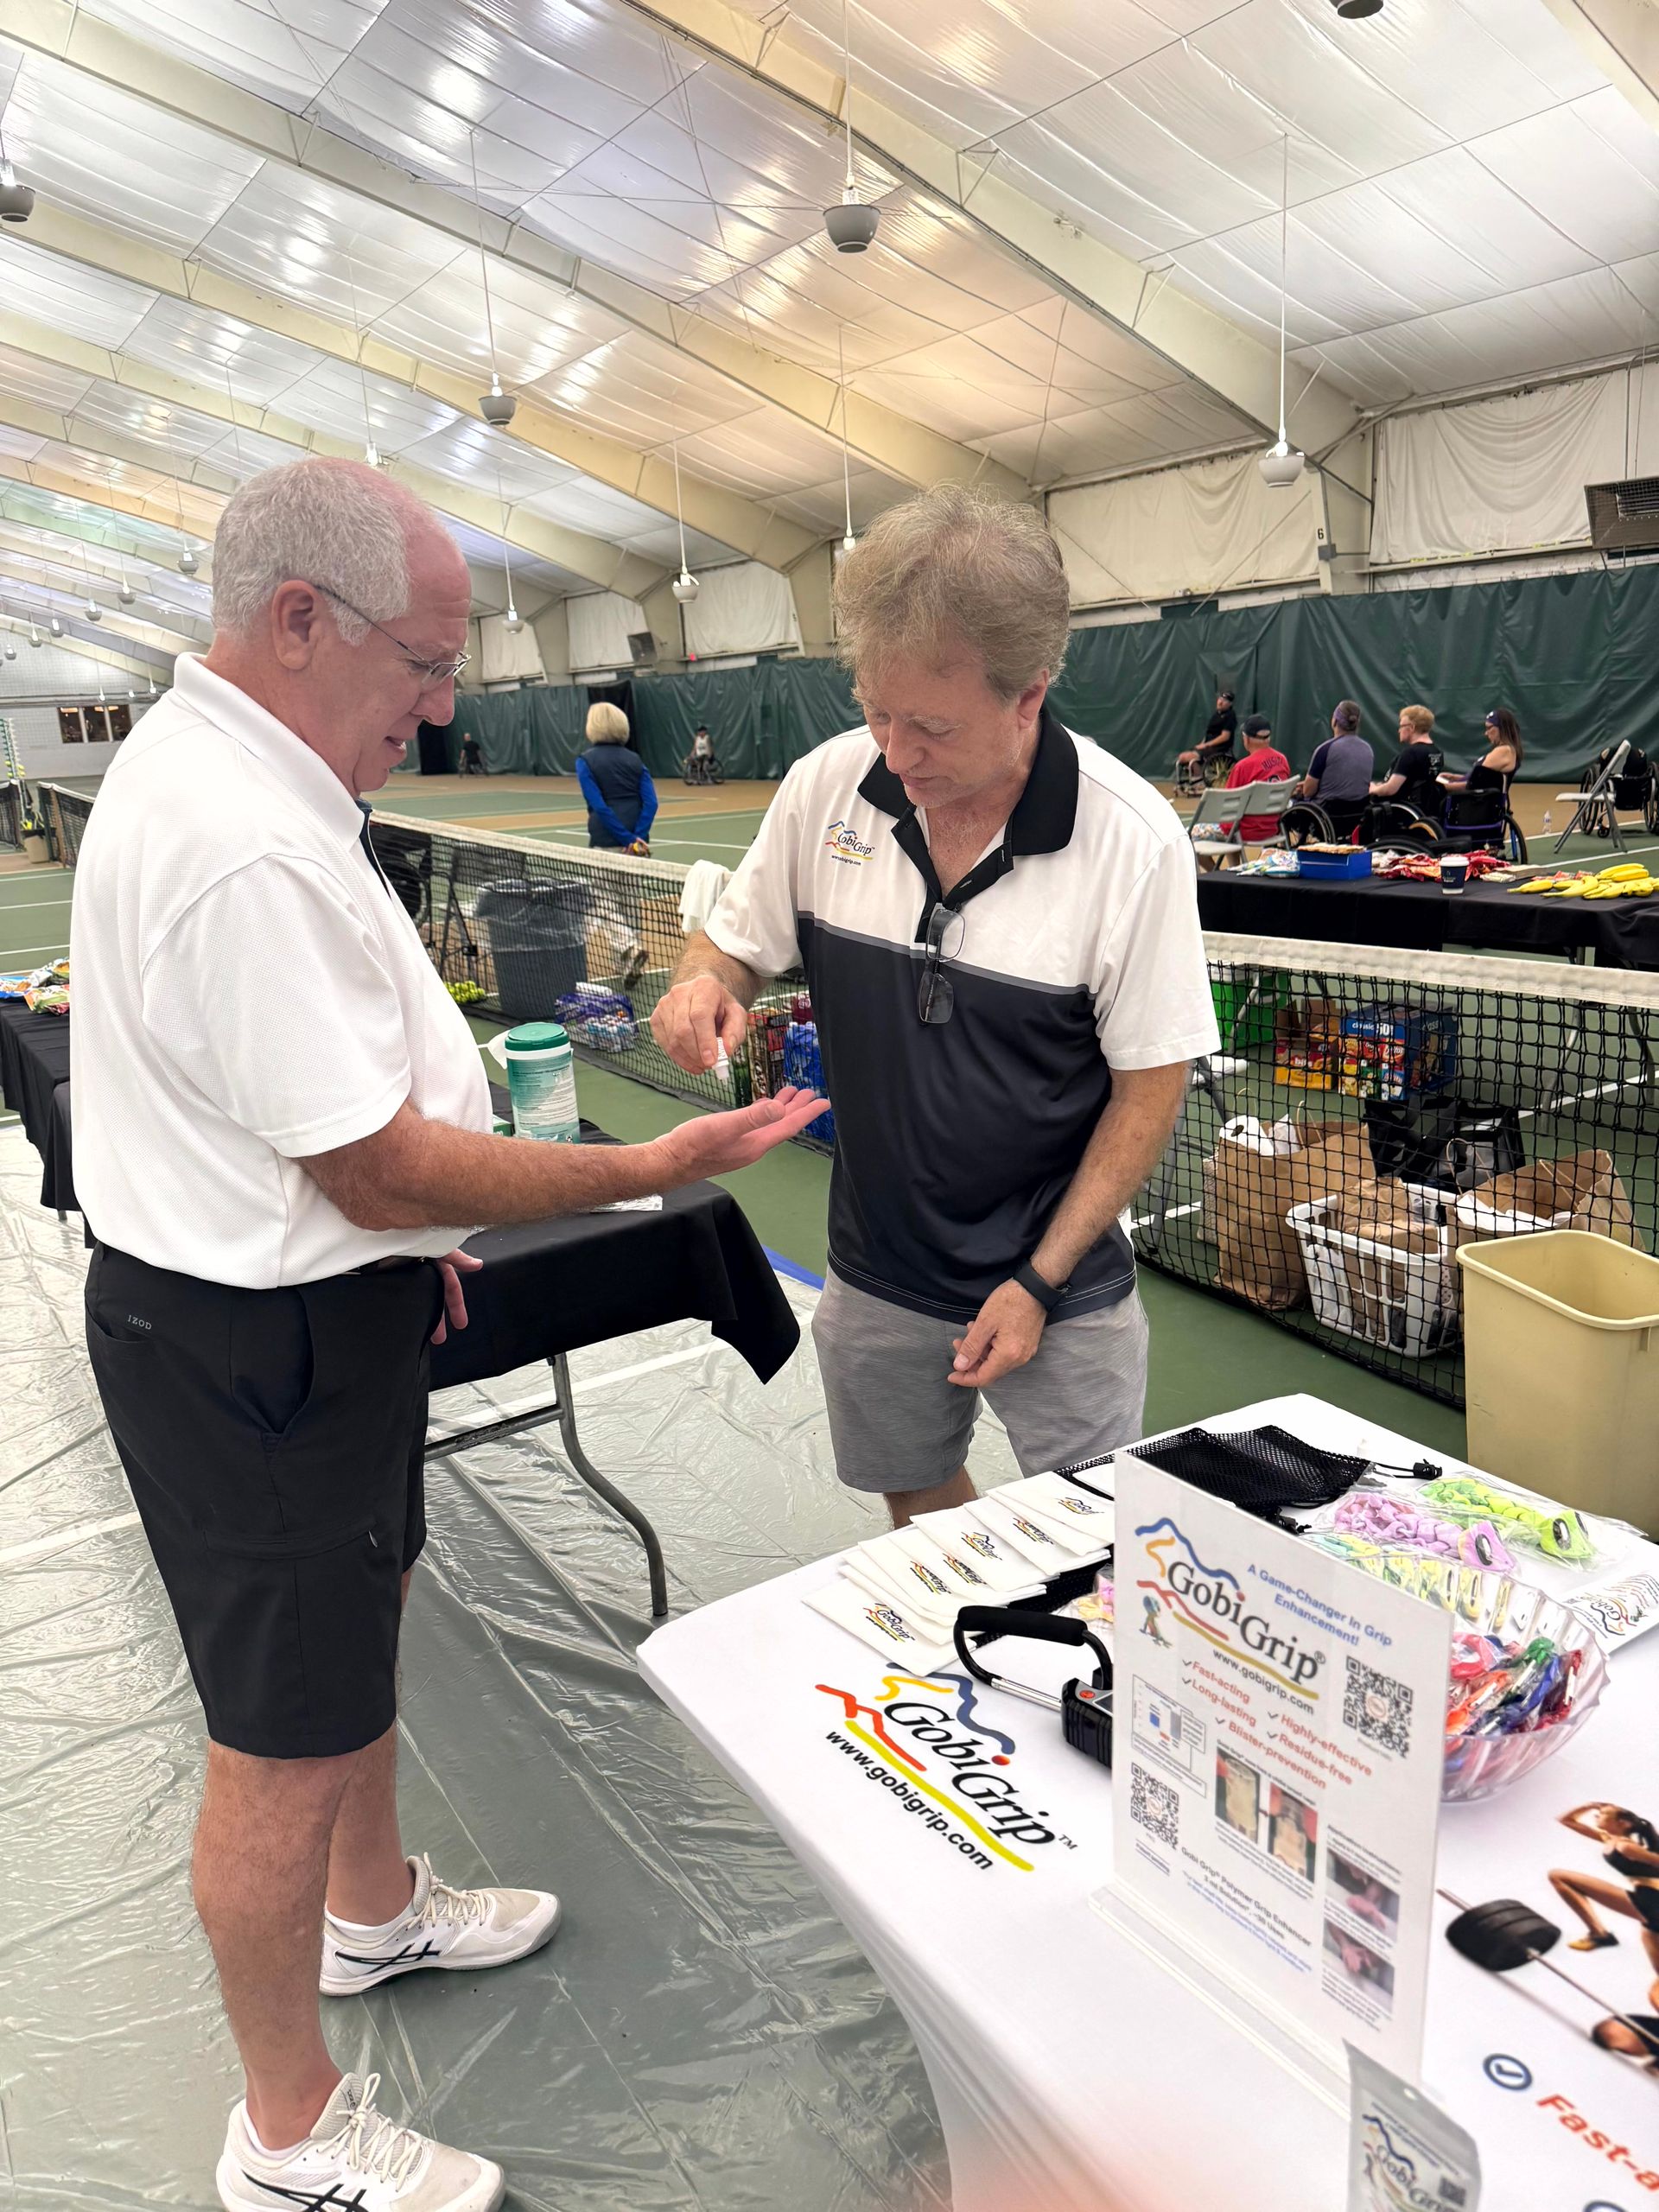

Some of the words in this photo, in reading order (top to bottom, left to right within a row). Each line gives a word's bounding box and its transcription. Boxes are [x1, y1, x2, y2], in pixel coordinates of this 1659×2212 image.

[1318, 528, 1324, 539] 6
[127, 1314, 152, 1331] IZOD
[1247, 1564, 1256, 1576] A
[1260, 1569, 1347, 1622] Game-Changer
[1349, 1617, 1361, 1630] In
[1364, 1624, 1393, 1647] Grip
[1274, 1593, 1360, 1646] Enhancement!
[1192, 1661, 1250, 1705] Fast-acting
[1192, 1679, 1256, 1727] Long-lasting
[1213, 1649, 1314, 1715] www.gobigrip.com
[1229, 1721, 1326, 1789] Blister-prevention
[1279, 1733, 1352, 1785] Residue-free
[1281, 1714, 1372, 1777] Highly-effective
[825, 1729, 996, 1871] www.gobigrip.com
[1222, 1876, 1253, 1903] Polymer
[1255, 1900, 1273, 1918] Grip
[1274, 1915, 1312, 1947] Enhancer
